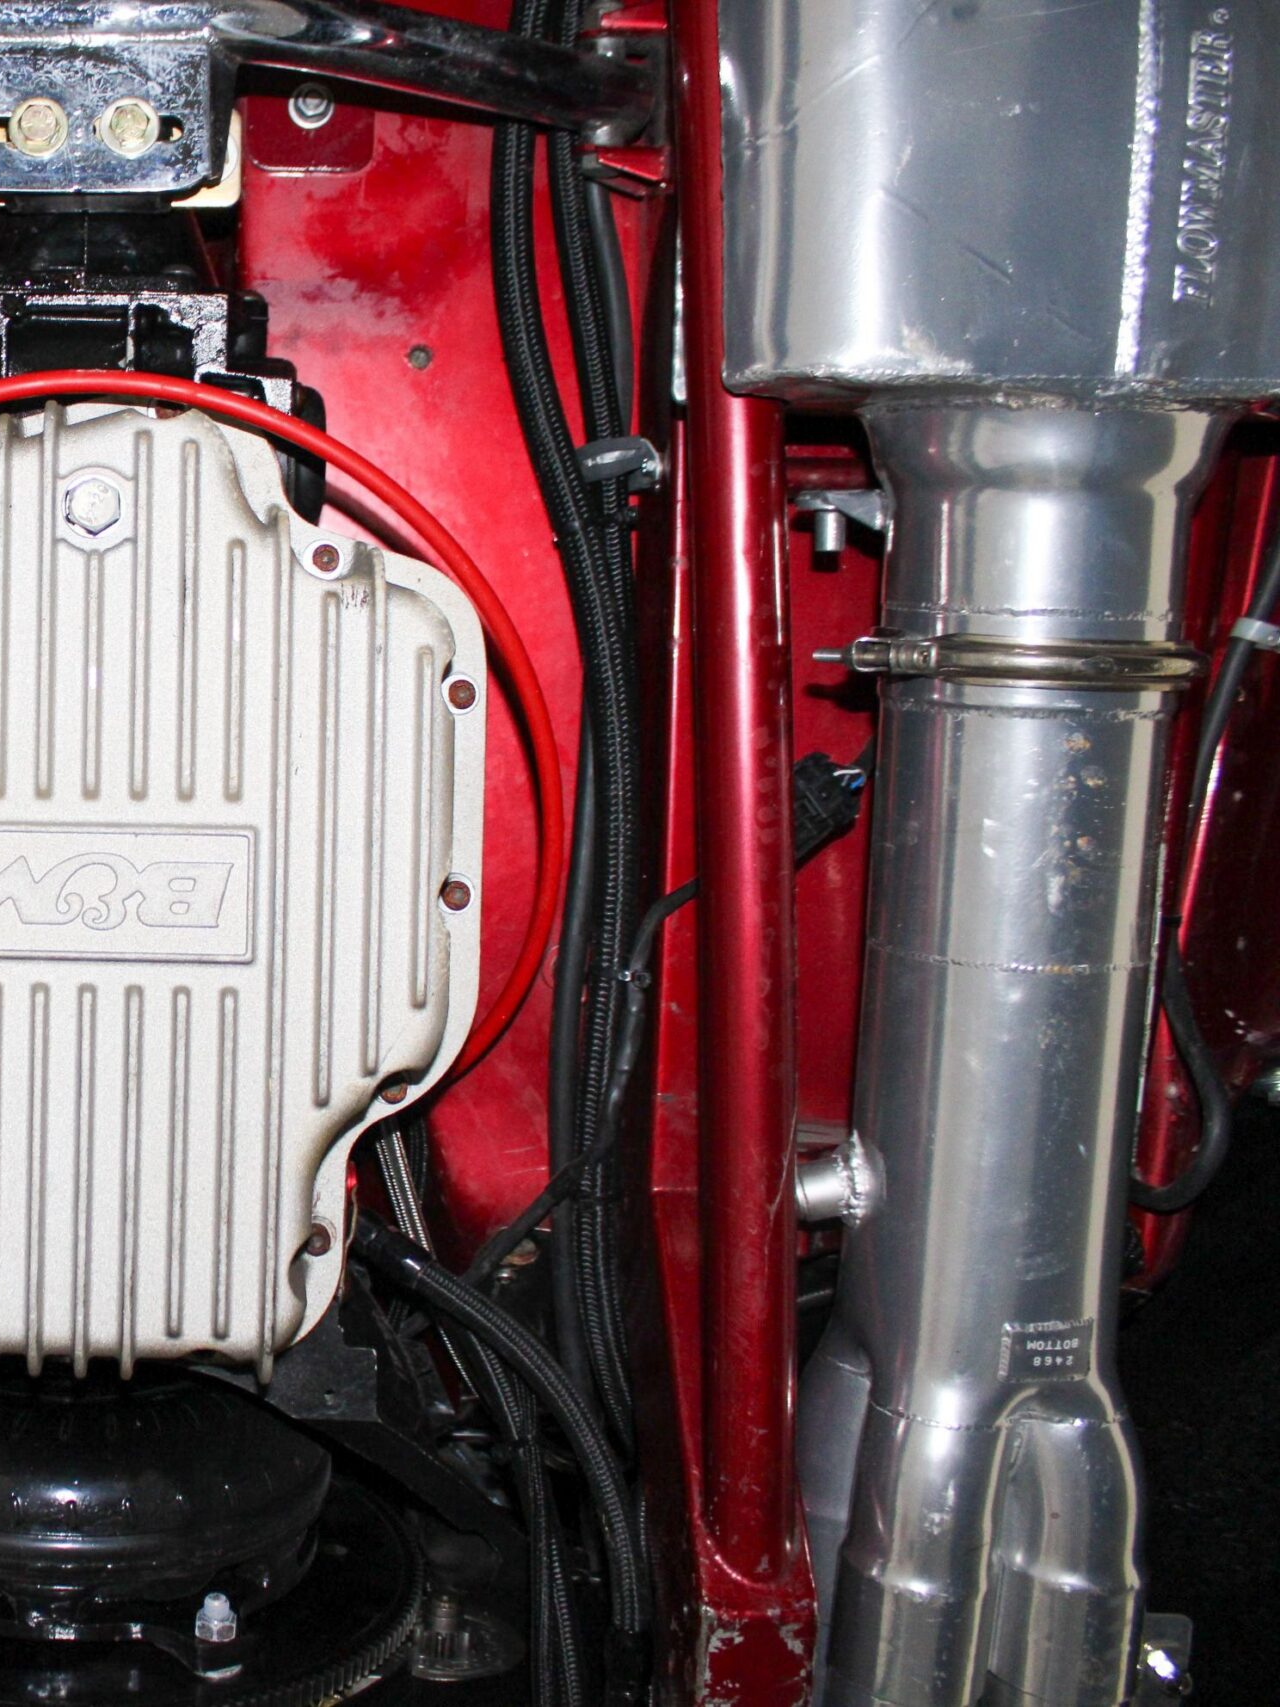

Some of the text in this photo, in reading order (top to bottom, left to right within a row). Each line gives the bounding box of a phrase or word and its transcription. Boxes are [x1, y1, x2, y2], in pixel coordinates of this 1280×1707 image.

[1171, 30, 1233, 308] FLOWMASTER
[1026, 1338, 1079, 1351] BOTTOM
[1033, 1355, 1074, 1367] 2468
